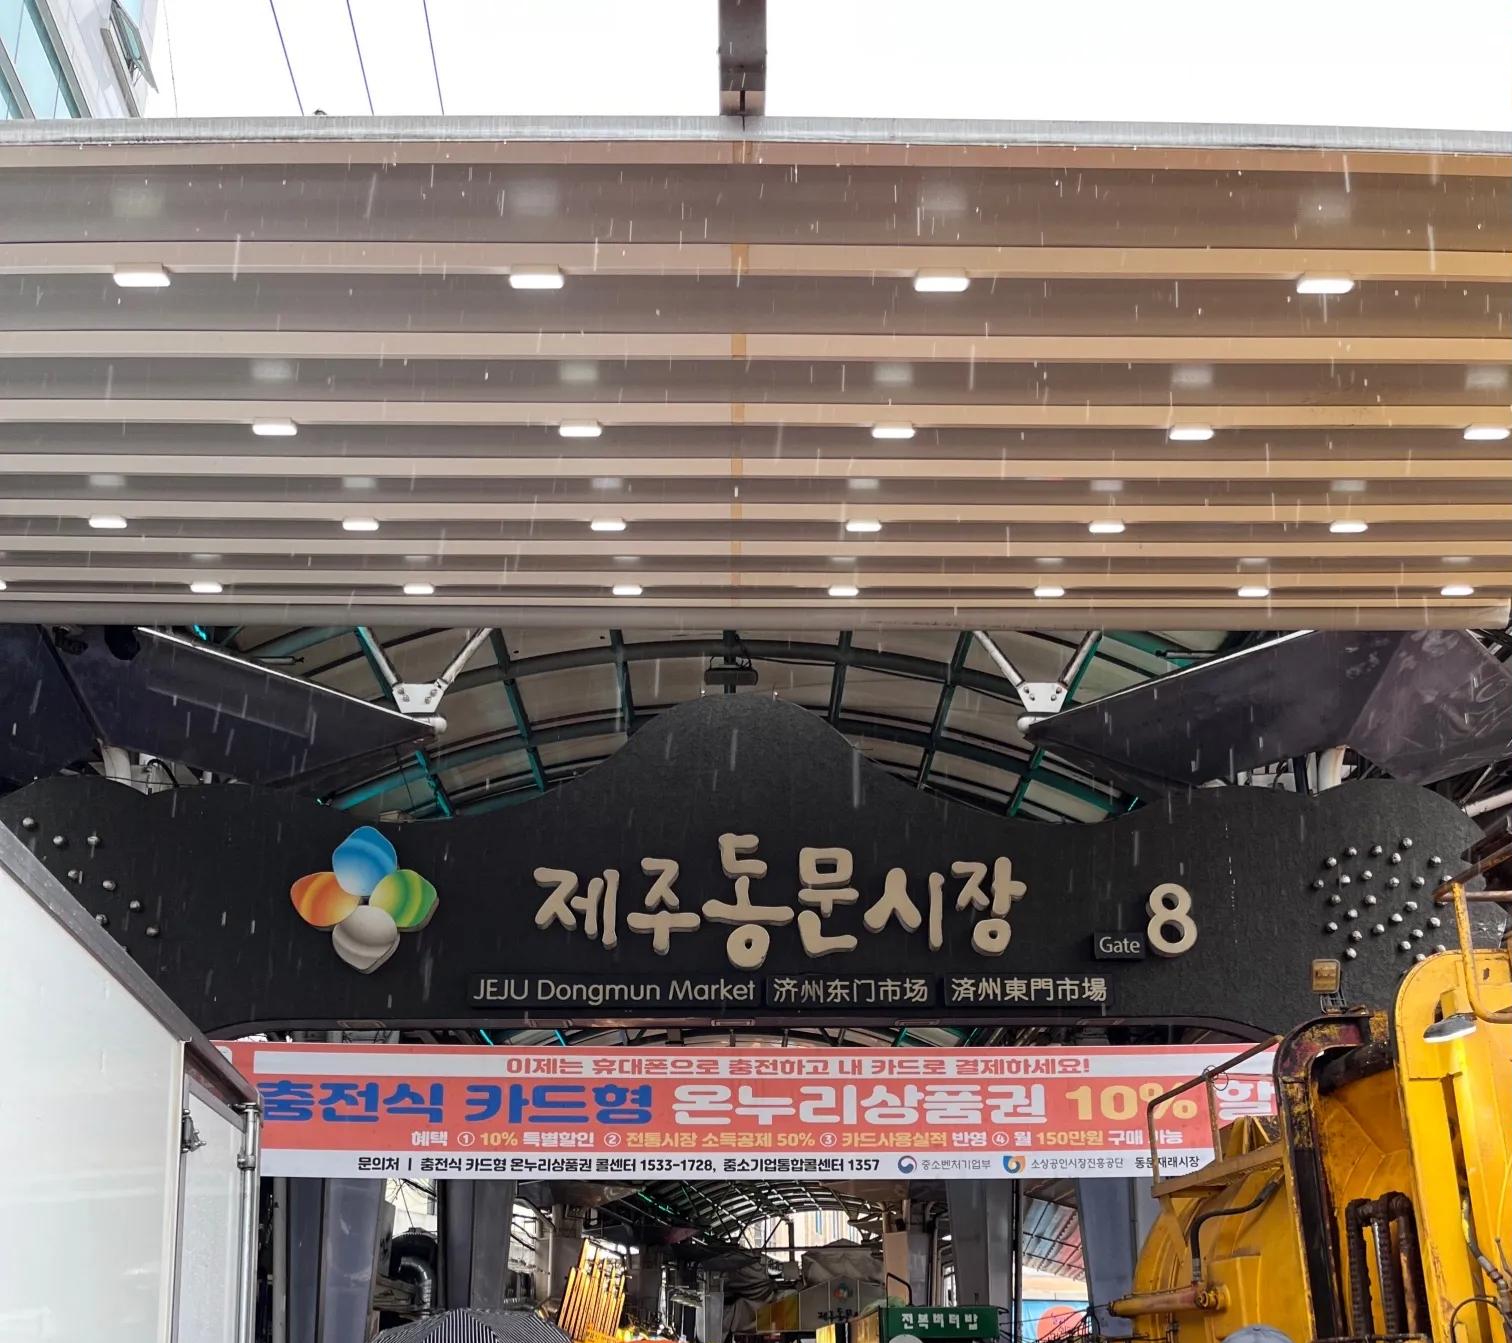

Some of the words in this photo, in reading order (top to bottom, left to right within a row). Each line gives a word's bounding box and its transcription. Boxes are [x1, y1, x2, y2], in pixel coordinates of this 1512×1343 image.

[533, 833, 1028, 971] 제주동문시장
[1099, 937, 1141, 955] Gate
[1145, 882, 1198, 957] 8
[473, 979, 529, 1001] JEJU
[537, 979, 660, 1006] Dongmun
[669, 978, 756, 1001] Market
[773, 977, 929, 1003] 济州东门市场
[951, 977, 1107, 1003] 済州東門市場
[507, 1057, 584, 1075] 이제는
[592, 1058, 719, 1075] 휴대폰으로
[729, 1058, 829, 1076] 충전하고
[839, 1059, 863, 1075] 내
[872, 1058, 946, 1075] 카드로
[955, 1057, 1090, 1075] 결제하세요!
[257, 1080, 444, 1123] 충전식
[464, 1083, 653, 1125] 카드형
[672, 1083, 1047, 1125] 온누리상품권
[1065, 1084, 1198, 1121] 10%
[411, 1131, 448, 1147] 혜택
[480, 1132, 518, 1147] 10%
[522, 1131, 594, 1148] 특별할인
[626, 1131, 698, 1148] 전통시장
[702, 1132, 772, 1148] 소득공제
[777, 1132, 815, 1147] 50%
[841, 1132, 947, 1148] 카드사용실적
[952, 1131, 987, 1147] 반영
[1014, 1131, 1032, 1147] 월
[1036, 1131, 1104, 1147] 150만원
[1107, 1130, 1143, 1146] 구매
[358, 1157, 400, 1172] 문의처
[420, 1157, 462, 1172] 충전식
[465, 1157, 506, 1172] 카드형
[510, 1157, 592, 1173] 온누리상품권
[596, 1157, 637, 1173] 콜센터
[640, 1158, 717, 1174] 1533-1728,
[723, 1158, 844, 1173] 중소기업통합콜센터
[848, 1159, 880, 1172] 1357
[921, 1159, 991, 1171] 중소벤처기업부
[1031, 1157, 1124, 1170] 소상공인시장진흥공단
[901, 1313, 979, 1331] 전복버터밥
